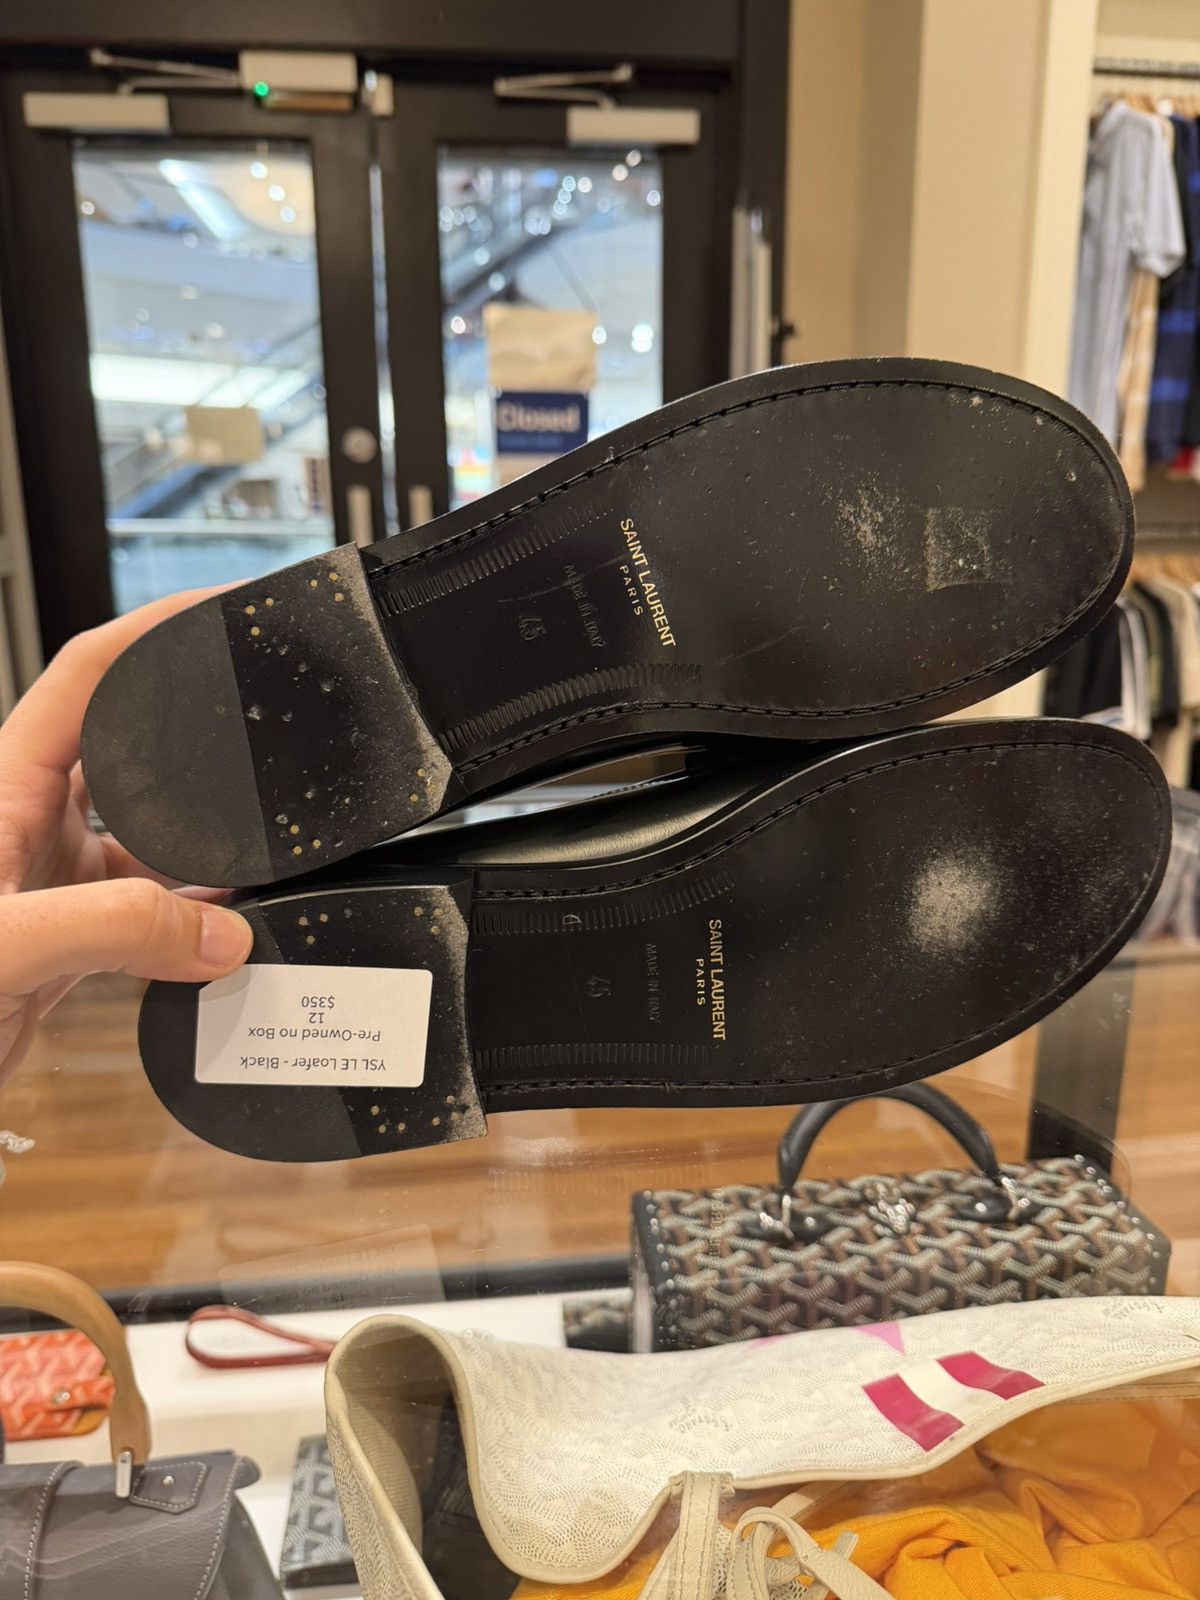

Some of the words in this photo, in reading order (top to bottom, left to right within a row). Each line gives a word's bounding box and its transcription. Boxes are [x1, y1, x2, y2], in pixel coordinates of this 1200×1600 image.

[497, 401, 581, 433] Closed
[620, 518, 649, 567] SAINT
[638, 570, 677, 647] LAURENT
[619, 564, 644, 616] PARIS
[709, 919, 724, 965] SAINT
[696, 958, 706, 1006] PARIS
[301, 996, 336, 1009] $350
[710, 968, 726, 1041] LAURENT
[308, 1012, 325, 1024] 12
[248, 1027, 275, 1040] Box
[279, 1028, 298, 1038] no
[302, 1028, 381, 1042] Pre-Owned
[240, 1056, 280, 1069] Black
[291, 1057, 338, 1071] Loafer
[341, 1058, 358, 1071] LE
[361, 1058, 386, 1071] YSL
